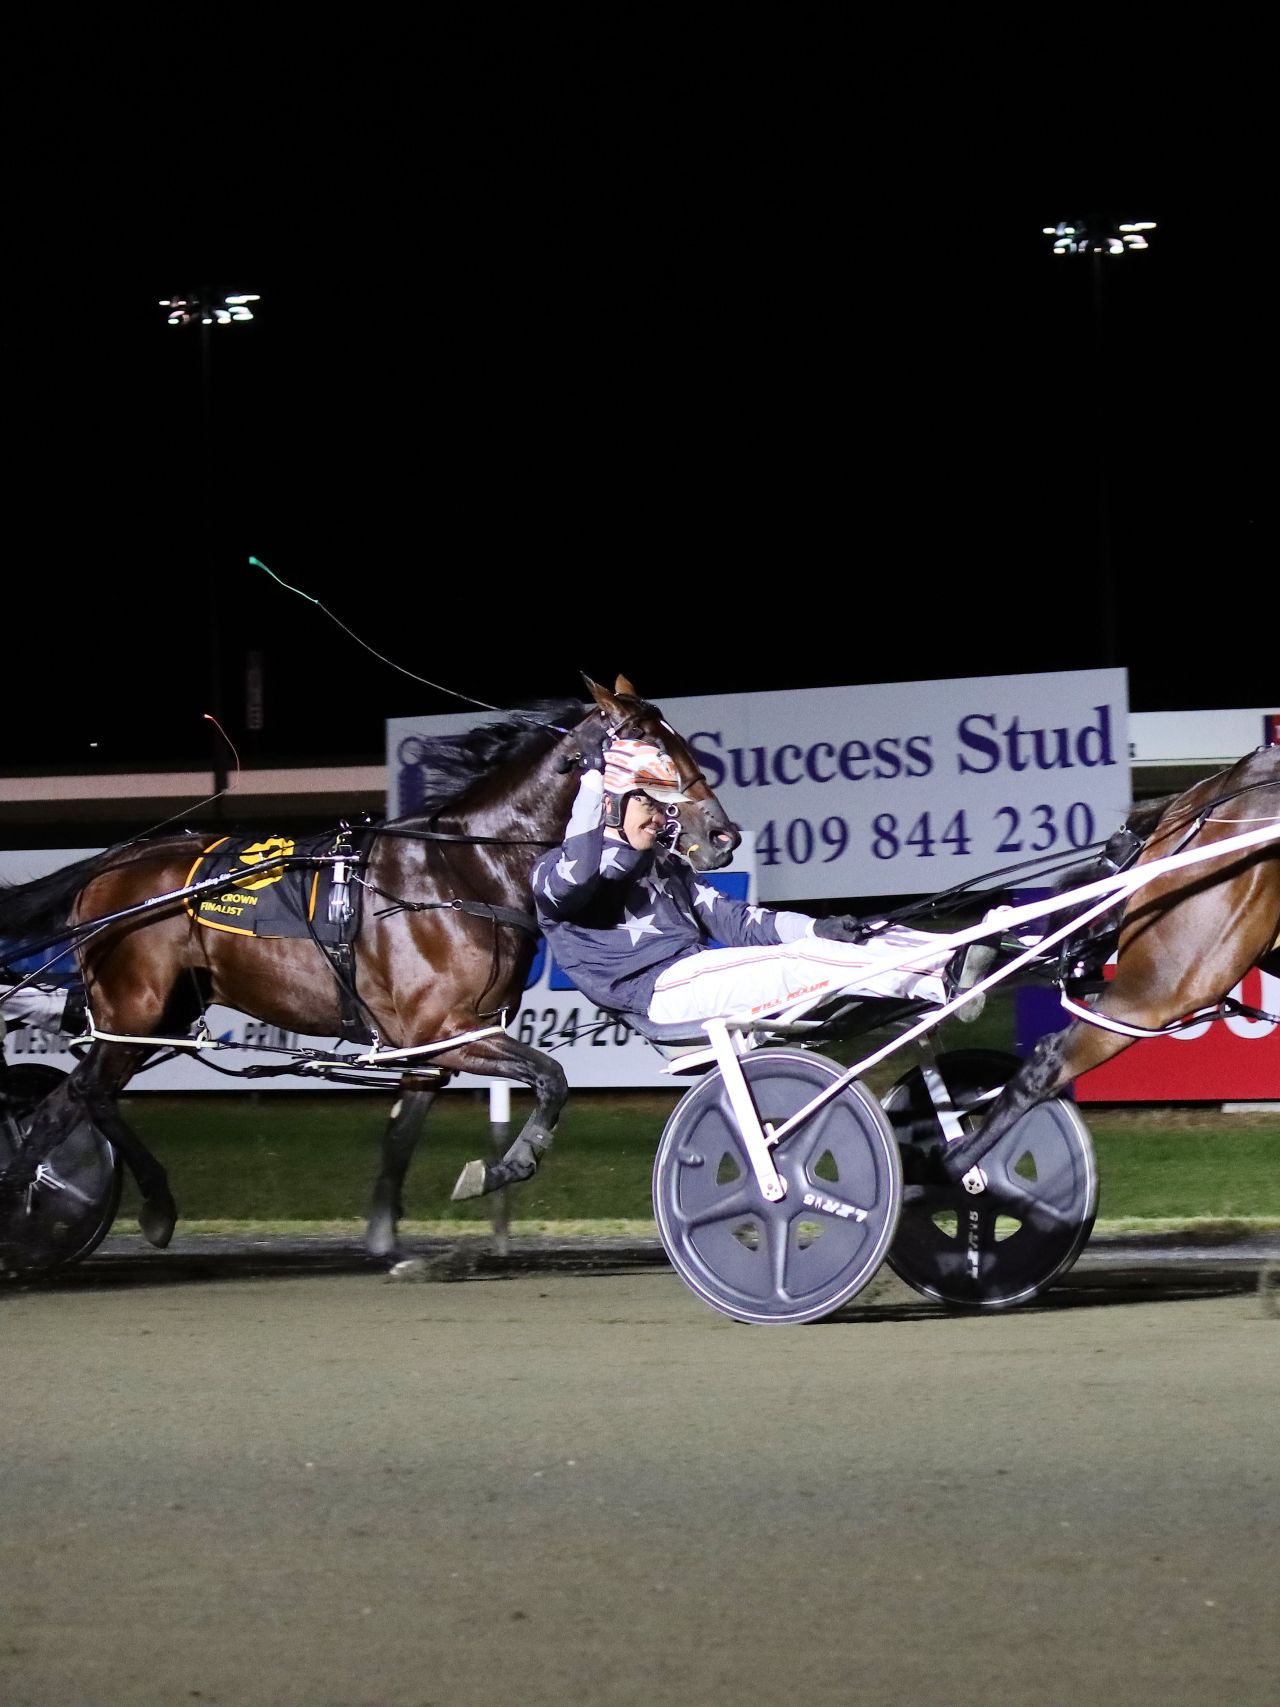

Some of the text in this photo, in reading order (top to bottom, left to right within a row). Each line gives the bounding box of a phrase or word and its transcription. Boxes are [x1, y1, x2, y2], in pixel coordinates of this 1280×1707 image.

[688, 704, 1117, 790] Success Stud
[731, 801, 1095, 866] 409 844 230
[200, 901, 244, 917] FINALIST
[220, 893, 258, 906] CROWN
[591, 1010, 649, 1047] 20
